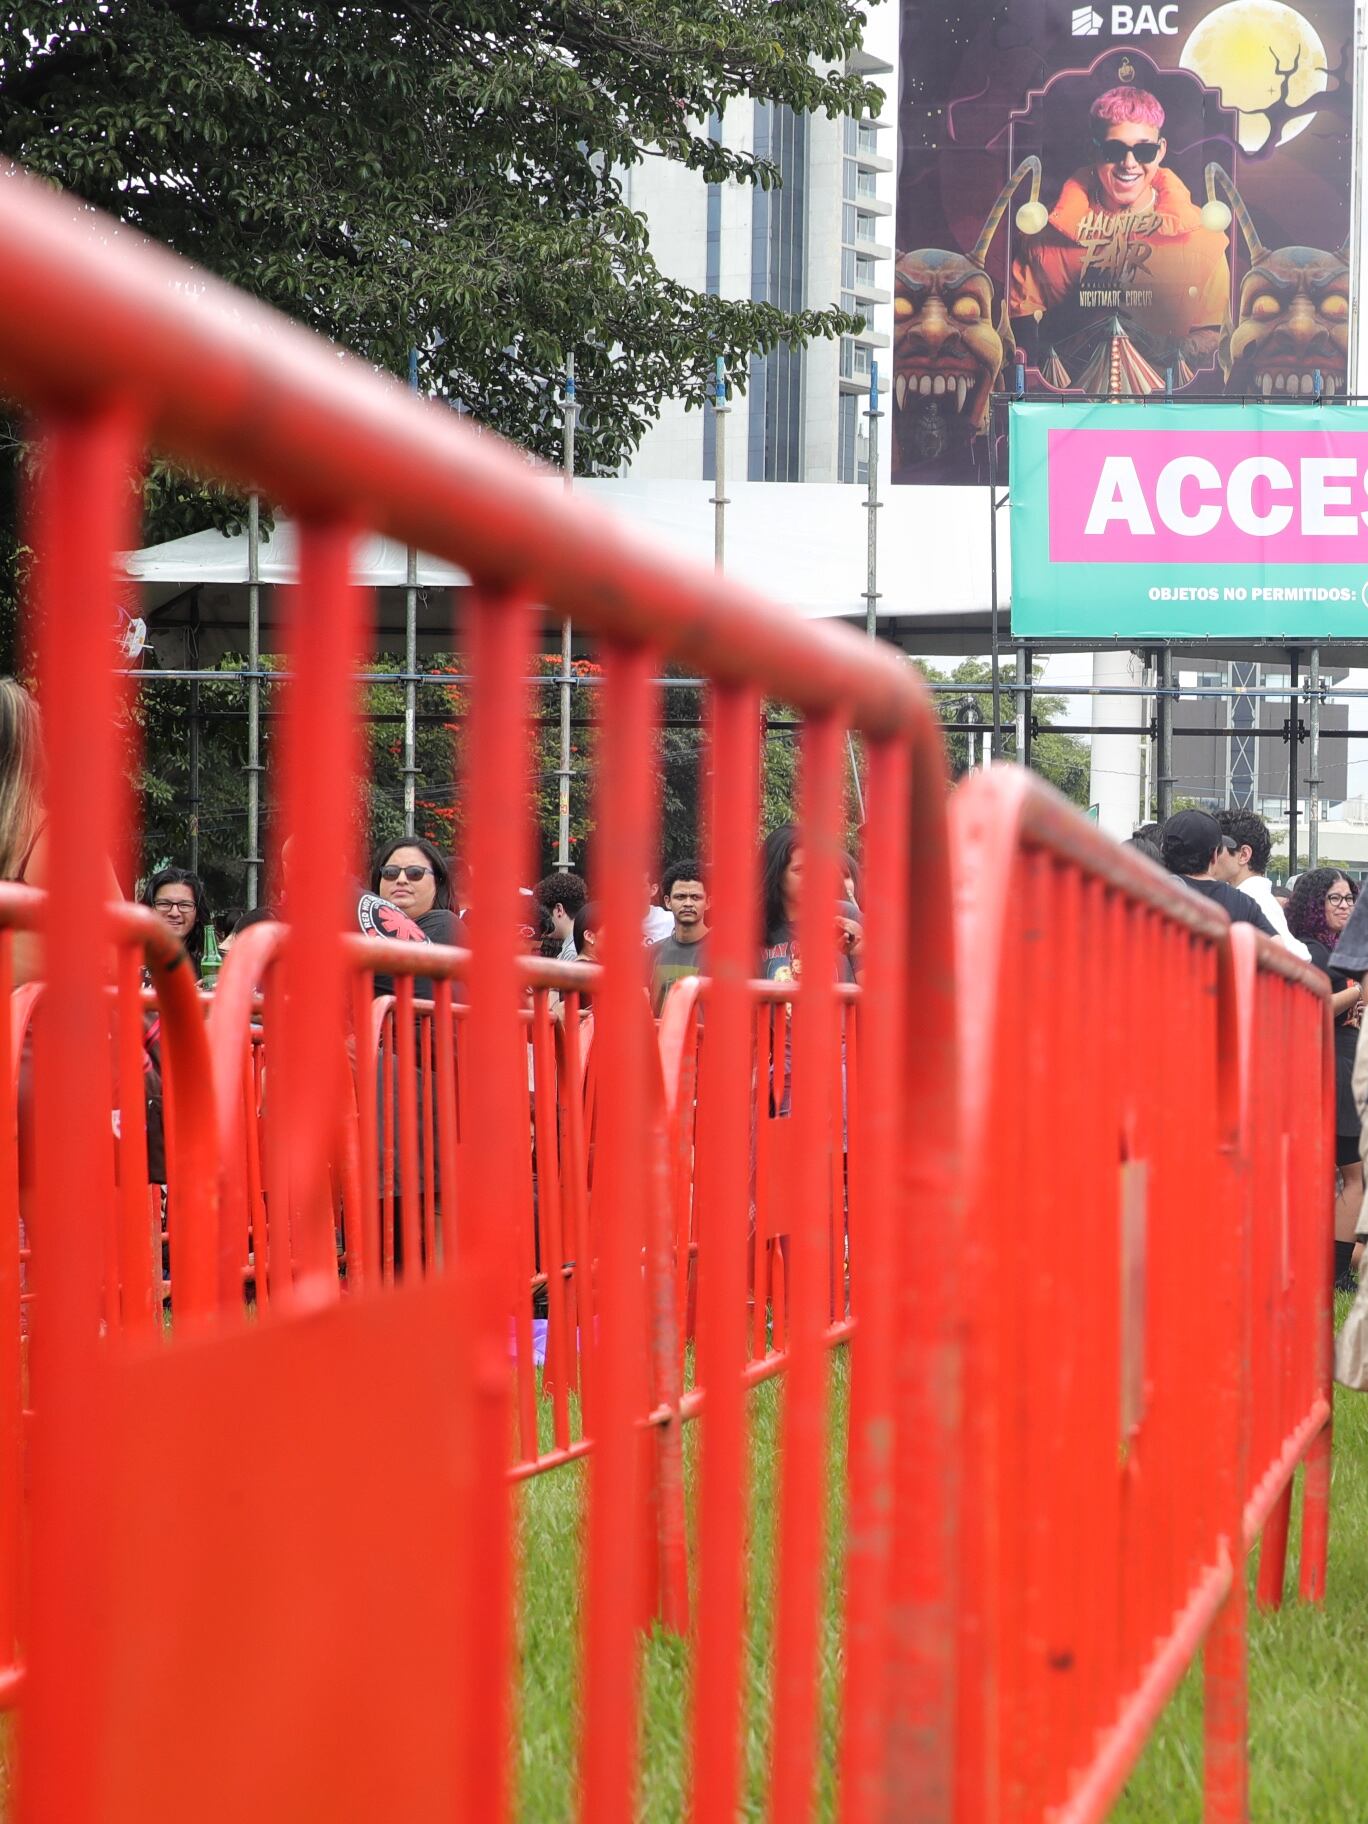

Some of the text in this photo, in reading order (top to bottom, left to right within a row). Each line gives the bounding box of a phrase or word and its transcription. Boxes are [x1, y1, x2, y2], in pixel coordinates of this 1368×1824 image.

[1111, 4, 1179, 35] BAC
[1076, 210, 1163, 240] HAUNTED
[1078, 239, 1154, 283] FAIR
[1148, 587, 1357, 601] OBJETOS NO PERMITIDOS:
[361, 912, 373, 929] RED
